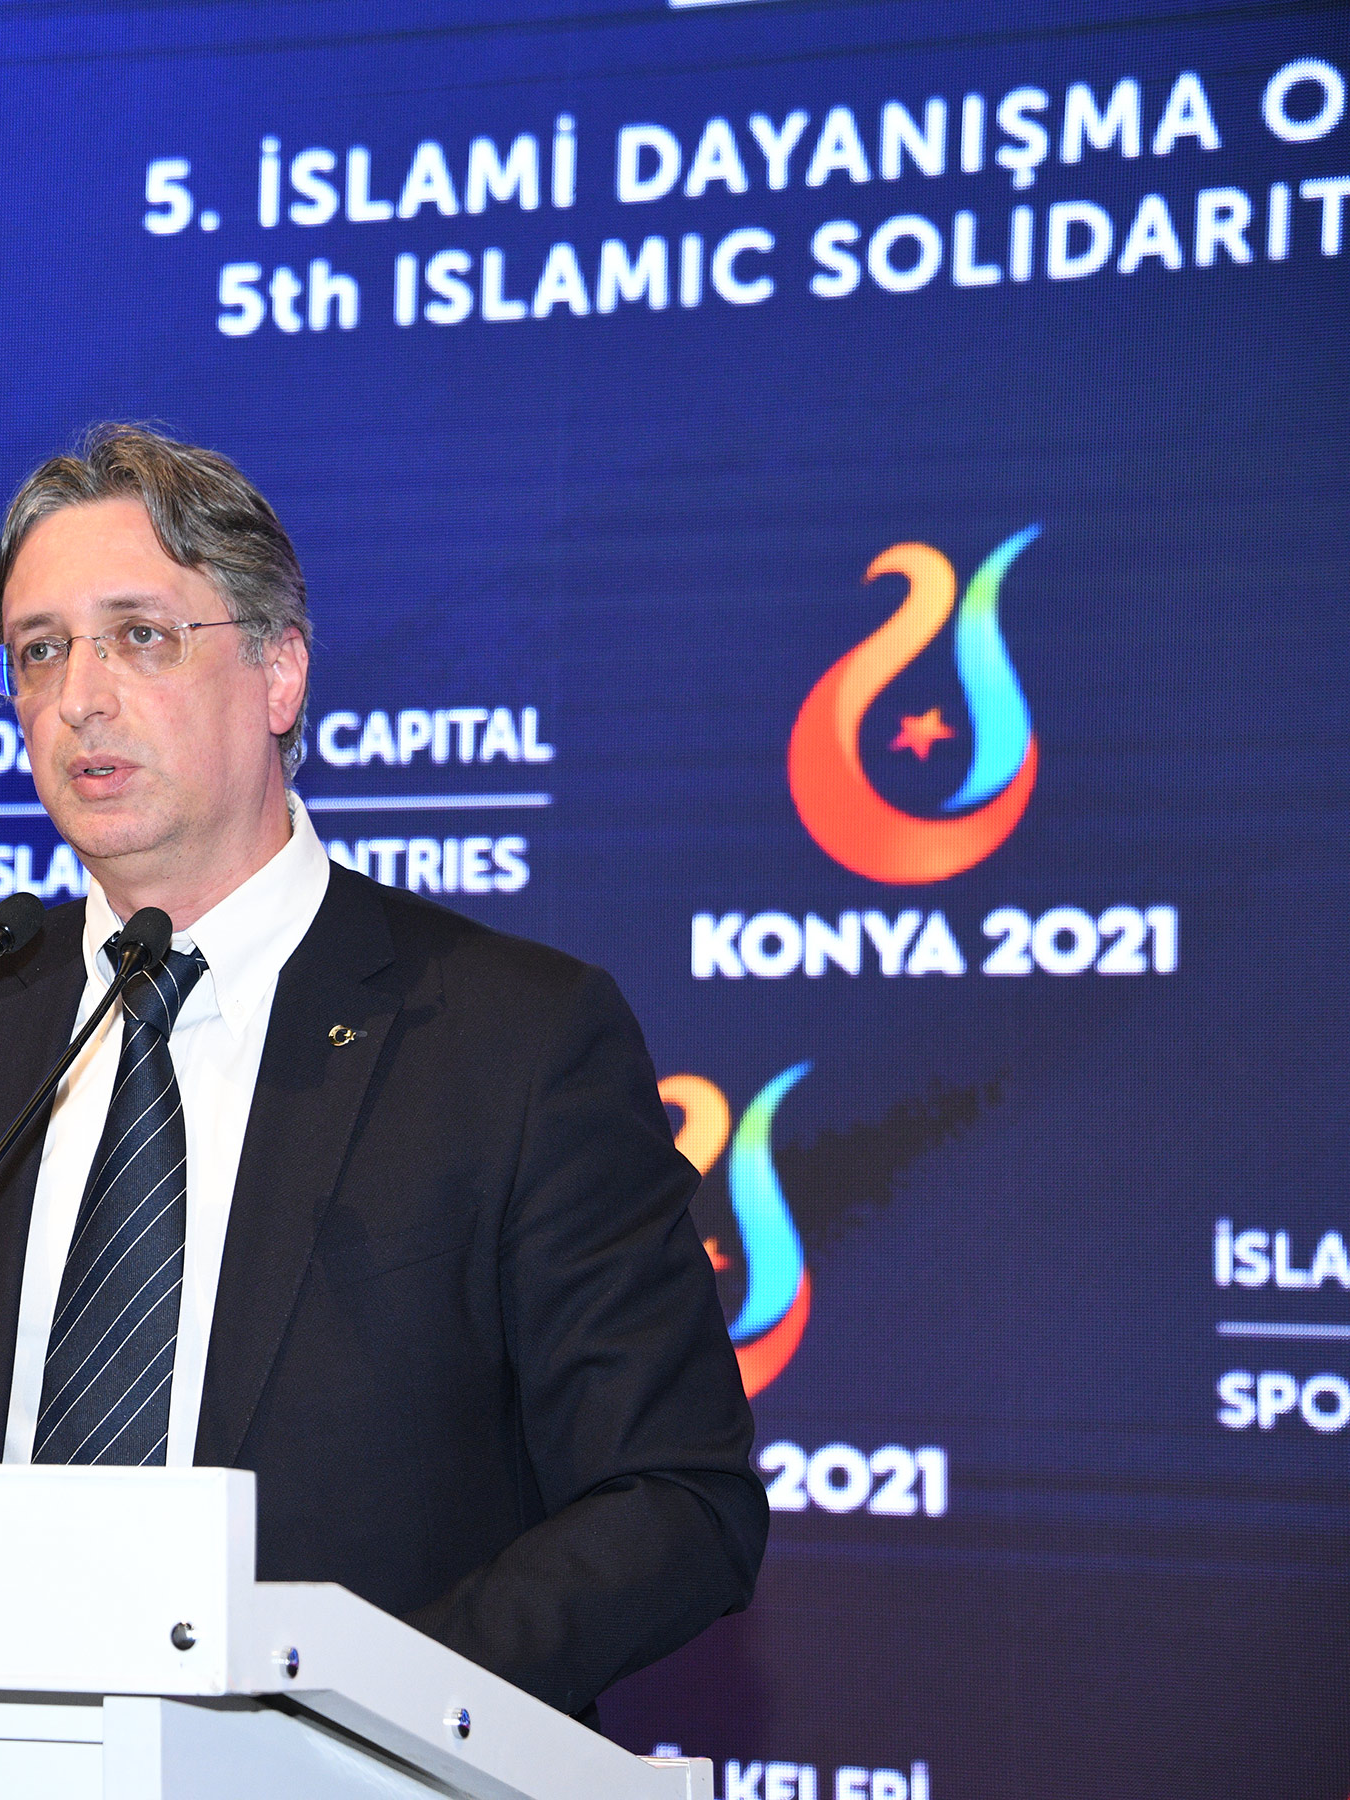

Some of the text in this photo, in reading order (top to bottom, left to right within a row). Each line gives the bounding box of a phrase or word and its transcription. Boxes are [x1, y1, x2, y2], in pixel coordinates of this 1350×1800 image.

[144, 158, 221, 235] 5.
[258, 114, 577, 228] İSLAMİ
[616, 72, 1222, 204] DAYANIŞMA
[217, 176, 1350, 336] 5th ISLAMIC SOLIDARIT
[317, 707, 555, 767] CAPITAL
[690, 906, 1179, 978] KONYA 2021
[1216, 1370, 1350, 1432] SPO
[758, 1441, 948, 1518] 2021
